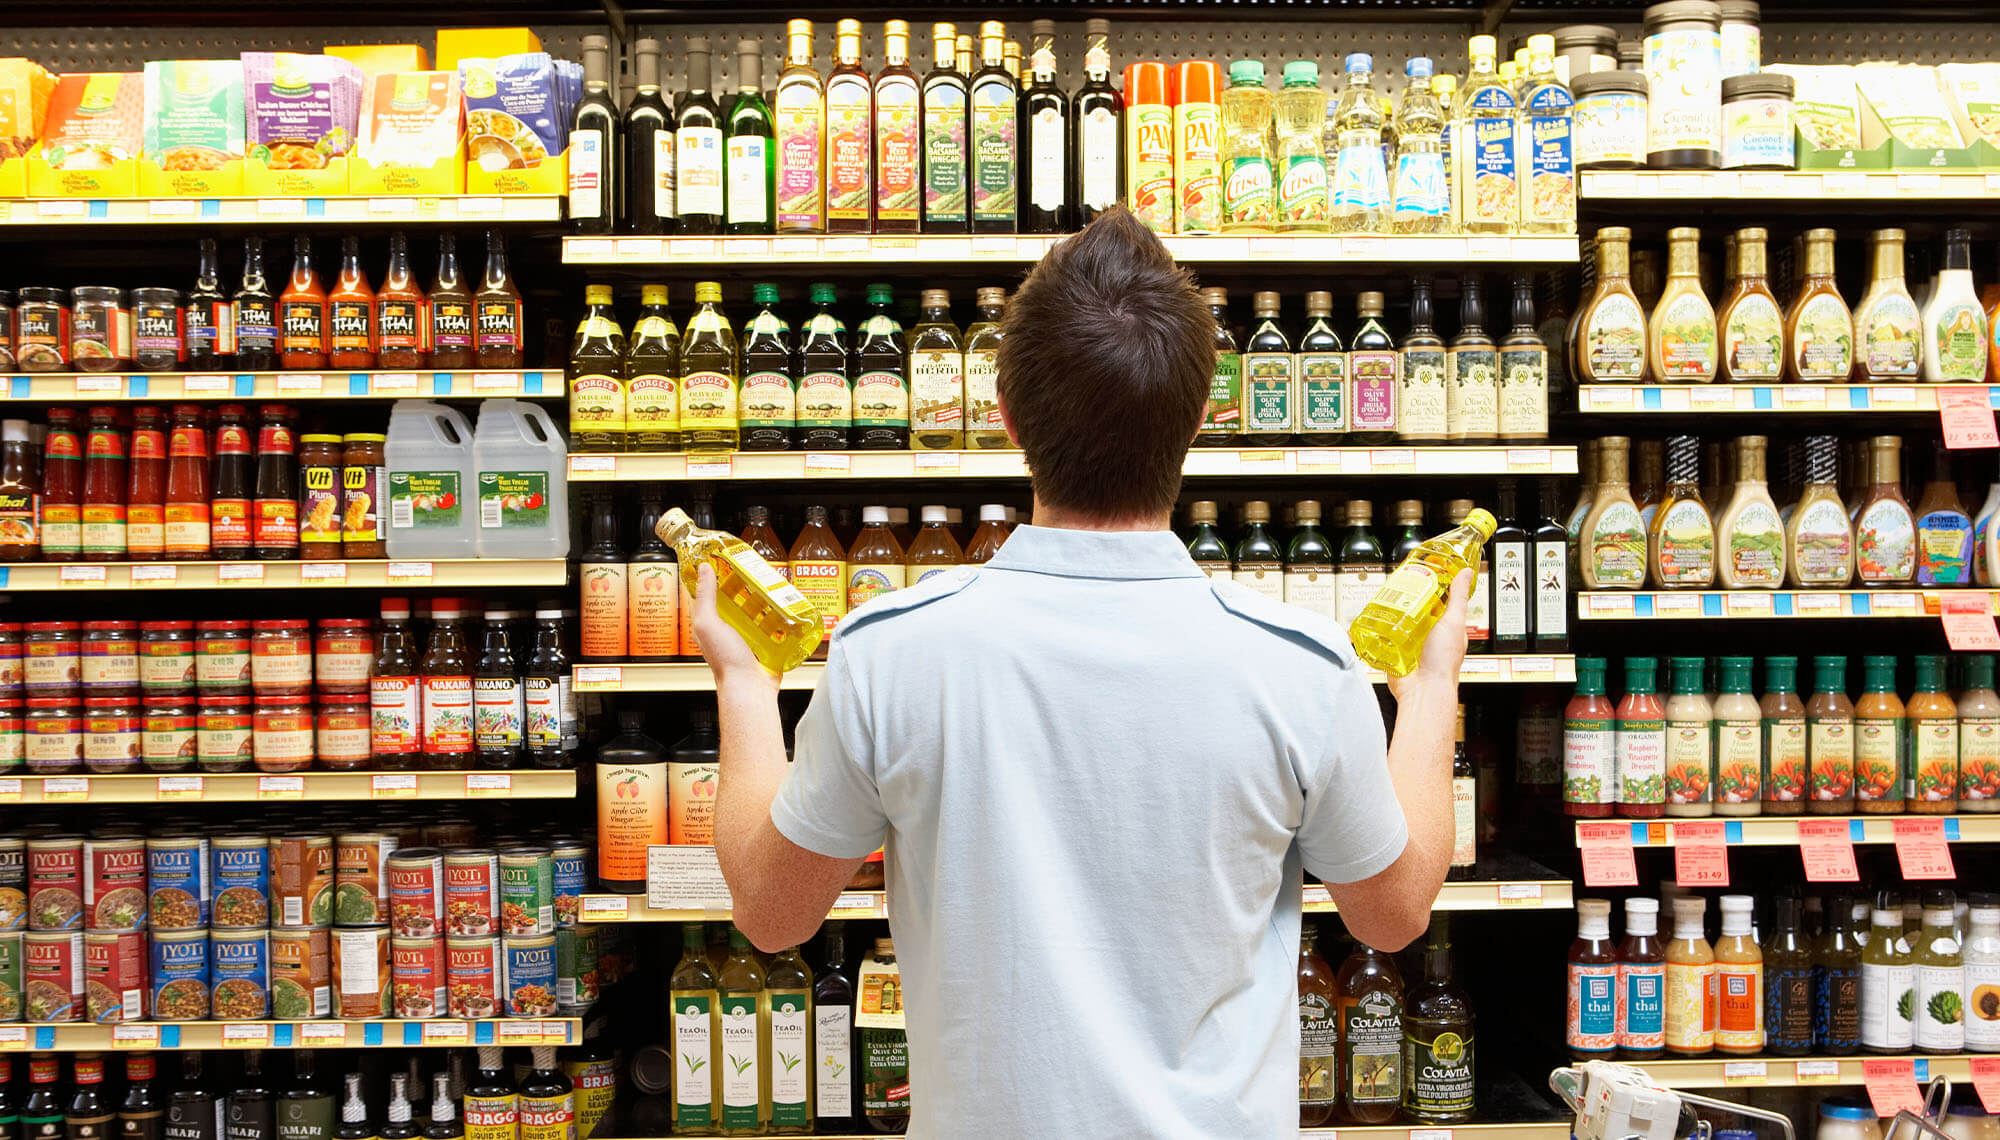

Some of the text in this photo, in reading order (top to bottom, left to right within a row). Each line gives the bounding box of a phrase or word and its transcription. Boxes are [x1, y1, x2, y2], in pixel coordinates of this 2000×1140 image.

[300, 101, 328, 109] Chicken
[1743, 134, 1783, 145] Coconut
[785, 150, 812, 159] WHITE
[840, 147, 858, 155] RED
[837, 154, 859, 162] WINE
[241, 310, 270, 321] THAI
[22, 321, 49, 333] THAI
[74, 320, 96, 331] THAI
[138, 319, 173, 332] THAI
[284, 318, 319, 331] THAI
[332, 318, 367, 331] THAI
[379, 317, 413, 330] THAI
[435, 316, 470, 330] THAI
[479, 316, 514, 329] THAI
[916, 367, 958, 376] BERIO
[577, 380, 615, 391] BORGES
[633, 380, 670, 391] BORGES
[688, 376, 725, 387] BORGES
[749, 375, 786, 386] BORGES
[807, 375, 842, 386] BORGES
[862, 375, 897, 386] BORGES
[308, 491, 331, 500] Plum
[345, 491, 364, 500] Plum
[796, 566, 838, 577] BRAGG
[431, 681, 470, 690] NAKANO
[1628, 744, 1657, 752] Raspberry
[606, 767, 650, 780] Omega Nutrition
[682, 768, 700, 779] Omega
[610, 807, 629, 816] Apple
[687, 806, 704, 814] Apple
[610, 816, 634, 824] Vinegar
[686, 815, 710, 823] Vinegar
[1697, 872, 1722, 880] $3.49
[1826, 868, 1851, 876] $3.49
[1588, 1000, 1610, 1012] thai
[1635, 1000, 1658, 1012] thai
[1726, 999, 1750, 1010] thai
[1350, 1016, 1401, 1029] COLAVITA
[1422, 1066, 1470, 1078] COLAVITA
[466, 1111, 515, 1125] BRAGG
[521, 1111, 566, 1125] BRAGG
[280, 1125, 322, 1136] TAMARI
[470, 1132, 494, 1140] LIQUID
[524, 1132, 546, 1140] LIQUID
